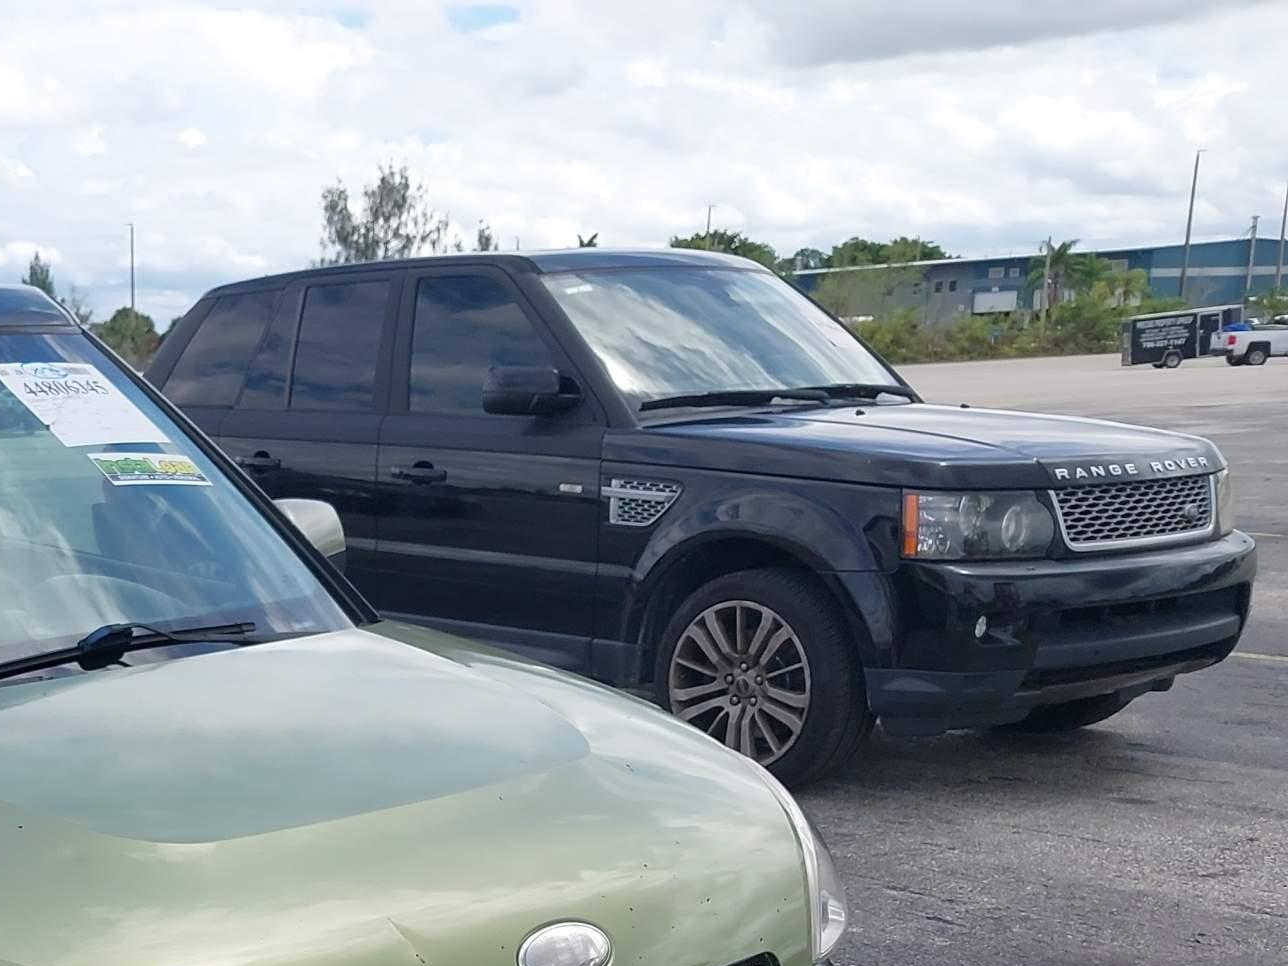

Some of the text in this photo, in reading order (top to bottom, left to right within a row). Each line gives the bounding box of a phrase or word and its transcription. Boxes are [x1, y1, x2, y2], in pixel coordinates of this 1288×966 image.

[24, 380, 110, 397] 44806345
[1055, 456, 1209, 480] RANGE ROVER
